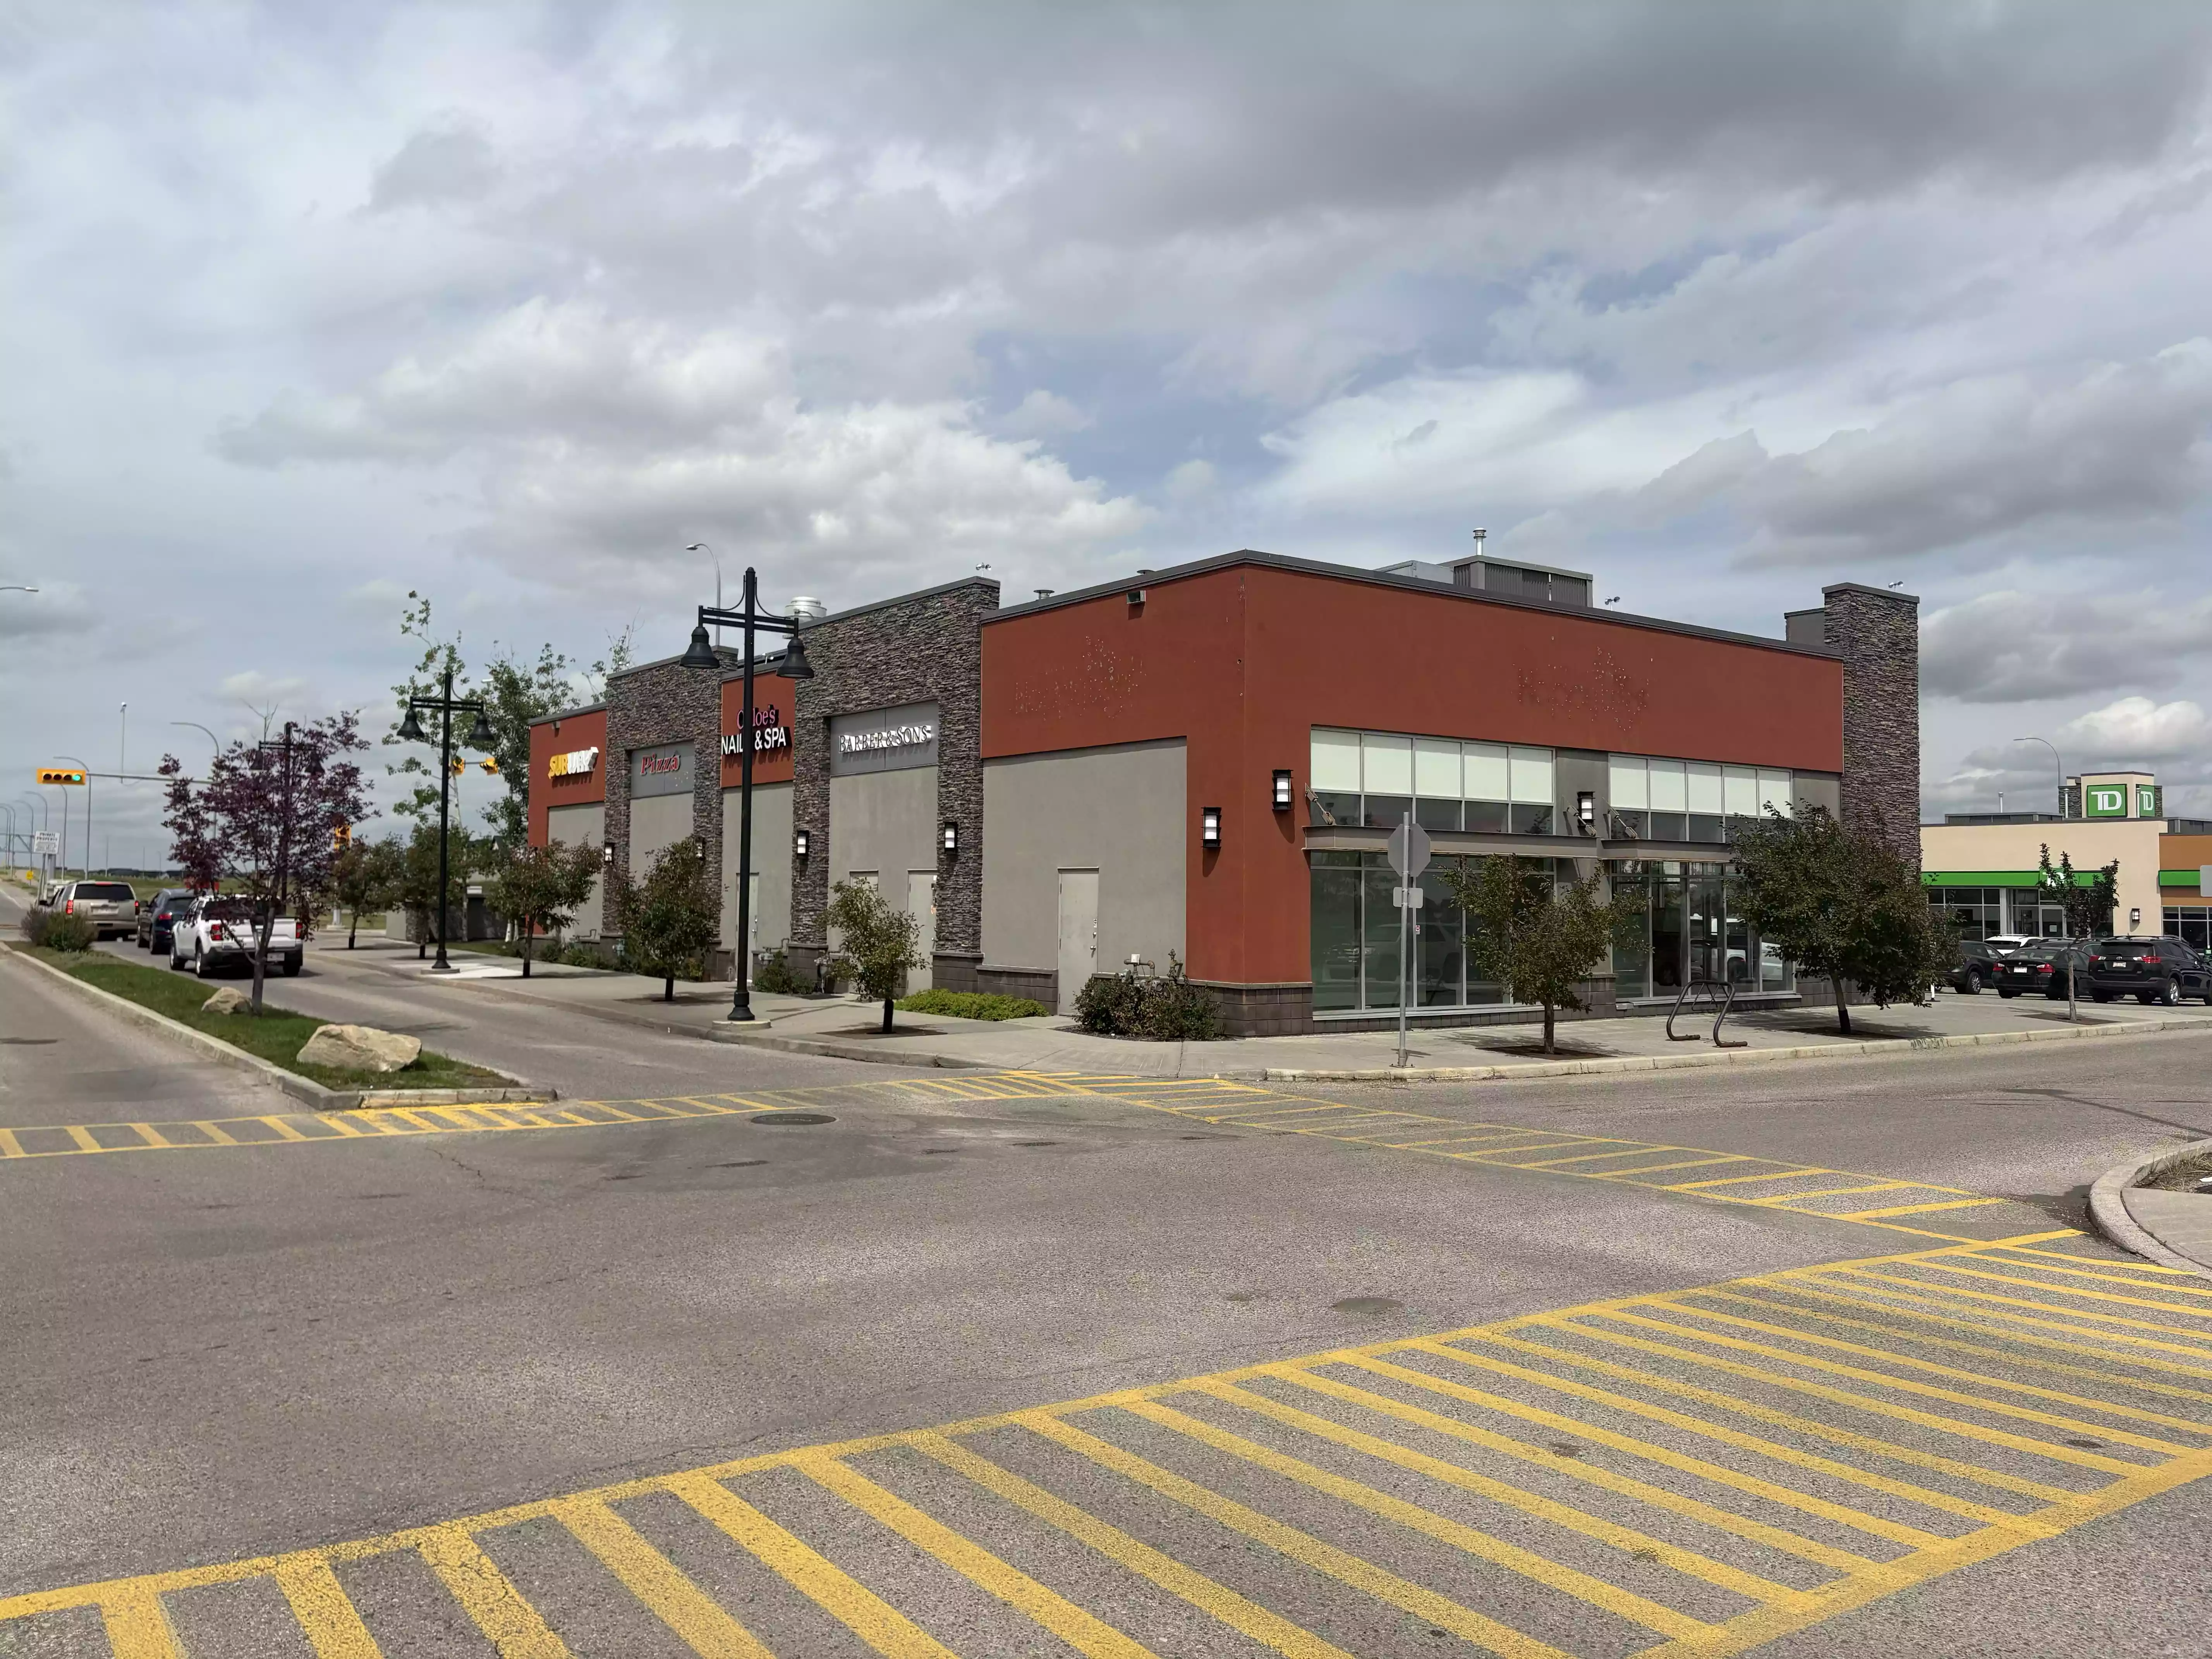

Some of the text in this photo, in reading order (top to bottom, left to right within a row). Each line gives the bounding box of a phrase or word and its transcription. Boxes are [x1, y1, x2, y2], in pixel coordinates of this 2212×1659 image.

[737, 704, 775, 730] Cloe's
[721, 726, 786, 755] NAIL & SPA
[839, 732, 884, 753] BARBER
[896, 725, 931, 745] SONS
[548, 747, 599, 779] SUBWAY
[640, 752, 680, 775] Pizza
[2091, 791, 2122, 810] TD
[2140, 791, 2154, 810] TD
